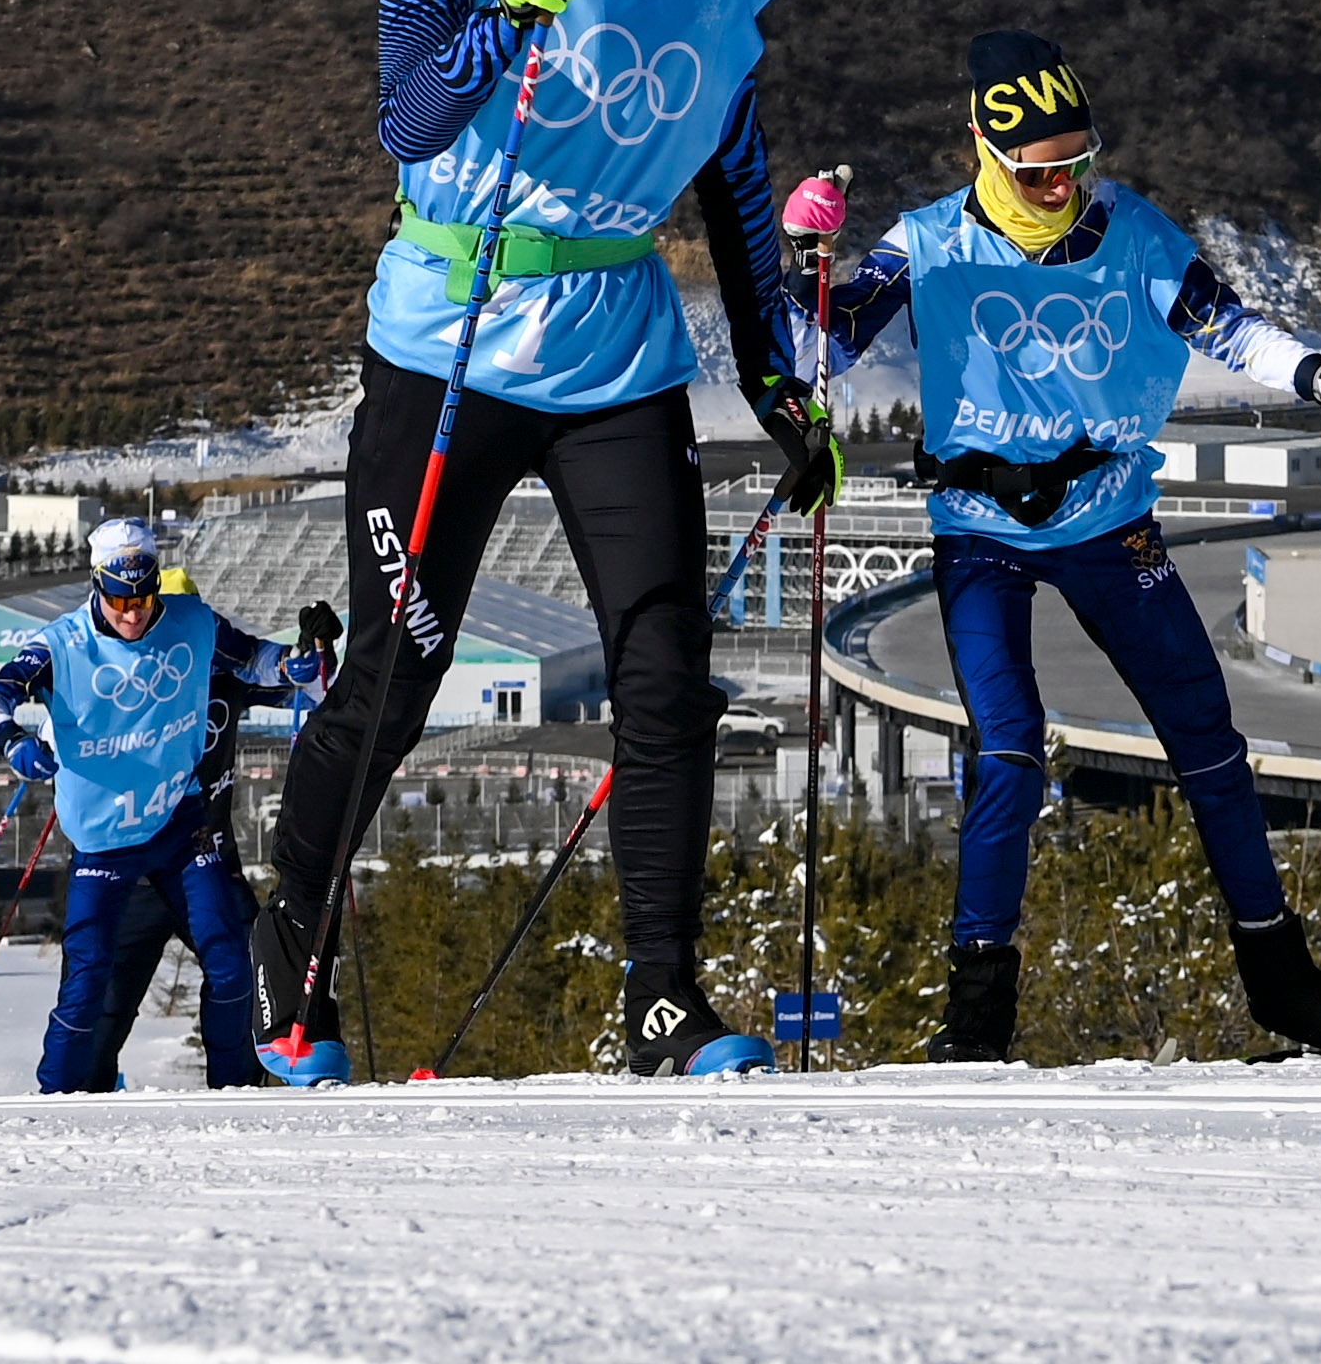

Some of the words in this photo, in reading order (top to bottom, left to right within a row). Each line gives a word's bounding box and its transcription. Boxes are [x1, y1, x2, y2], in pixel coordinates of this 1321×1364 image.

[983, 64, 1089, 132] SW
[953, 398, 1074, 445] BEIJING
[366, 507, 445, 660] ESTONIA
[78, 728, 157, 760] BEIJING
[75, 868, 111, 879] CRAFT
